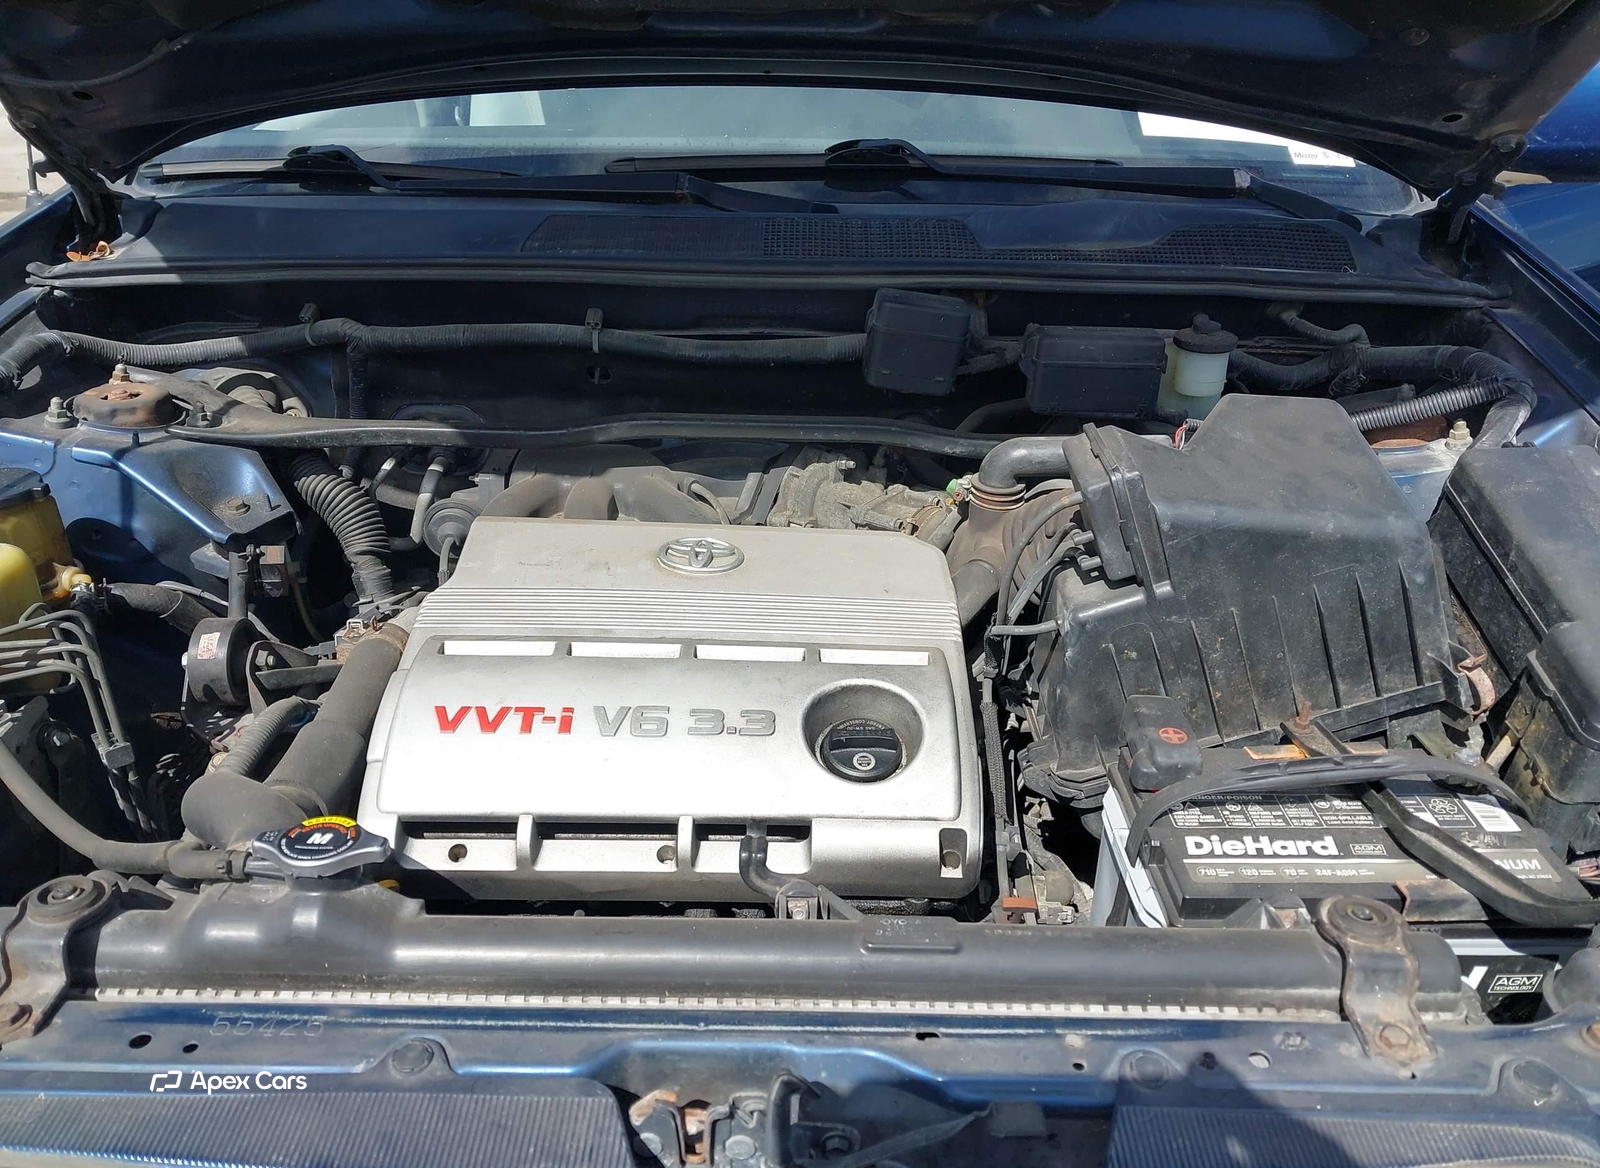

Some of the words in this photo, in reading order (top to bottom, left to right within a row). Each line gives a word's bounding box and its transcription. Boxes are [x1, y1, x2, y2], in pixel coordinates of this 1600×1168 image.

[434, 705, 575, 735] VVT-i
[593, 705, 670, 737] V6
[687, 708, 776, 737] 3.3
[1184, 835, 1339, 856] DieHard
[1199, 868, 1217, 876] 710
[1241, 868, 1259, 876] 120
[1283, 868, 1297, 876] 70
[1494, 859, 1542, 870] NUM
[1495, 976, 1538, 986] AGM
[209, 1015, 328, 1037] 55425
